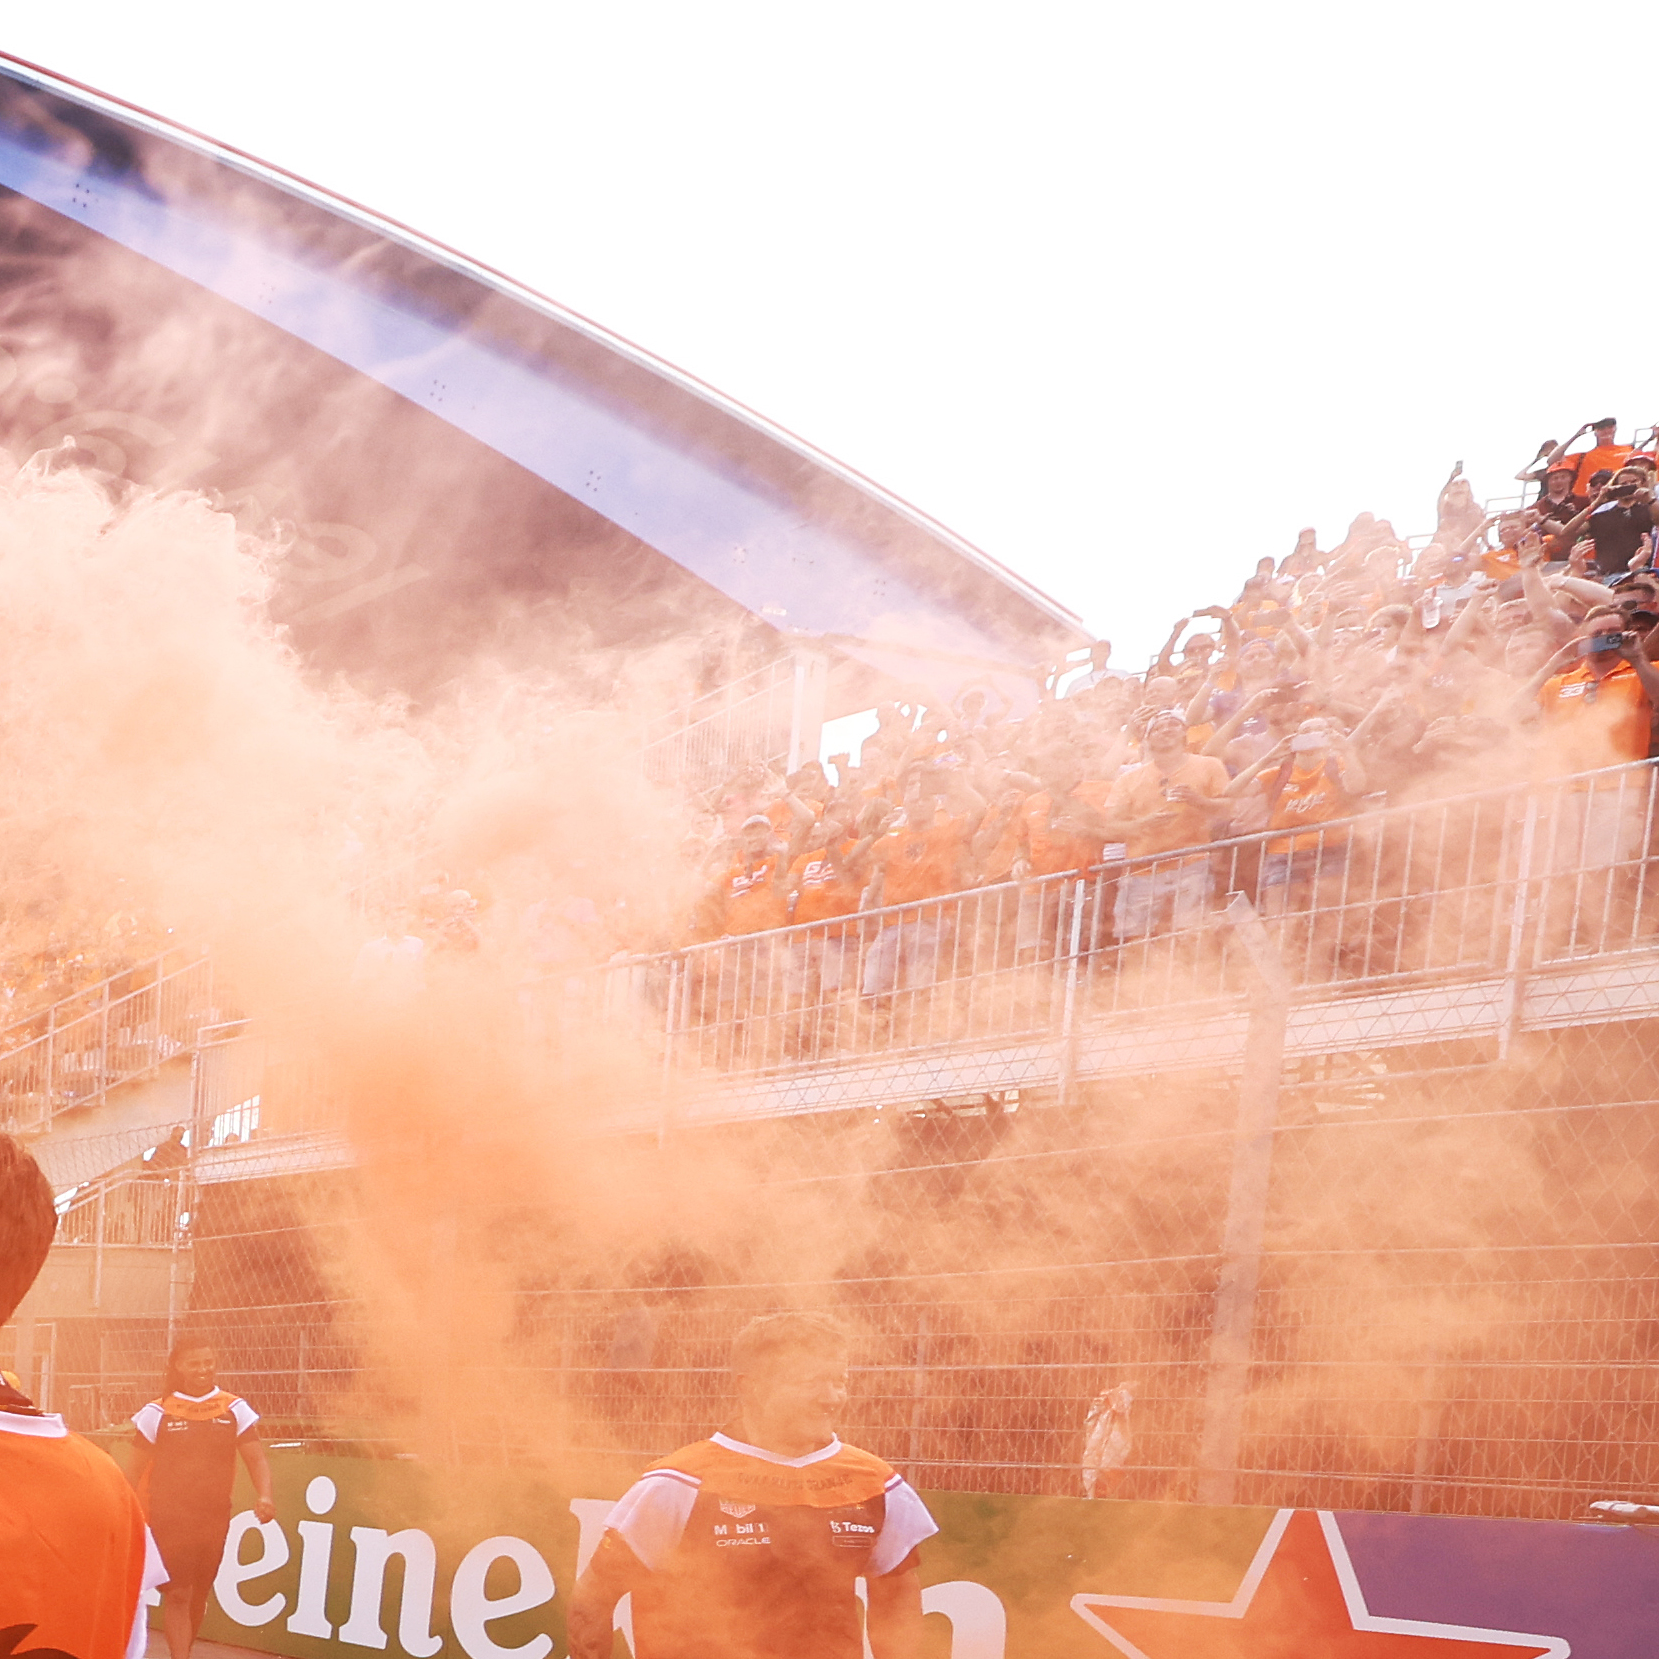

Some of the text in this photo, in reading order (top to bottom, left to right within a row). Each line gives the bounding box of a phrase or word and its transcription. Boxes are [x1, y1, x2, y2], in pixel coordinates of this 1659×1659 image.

[714, 1522, 754, 1536] Mbil
[843, 1521, 875, 1533] Tezos
[716, 1537, 772, 1547] ORACLE
